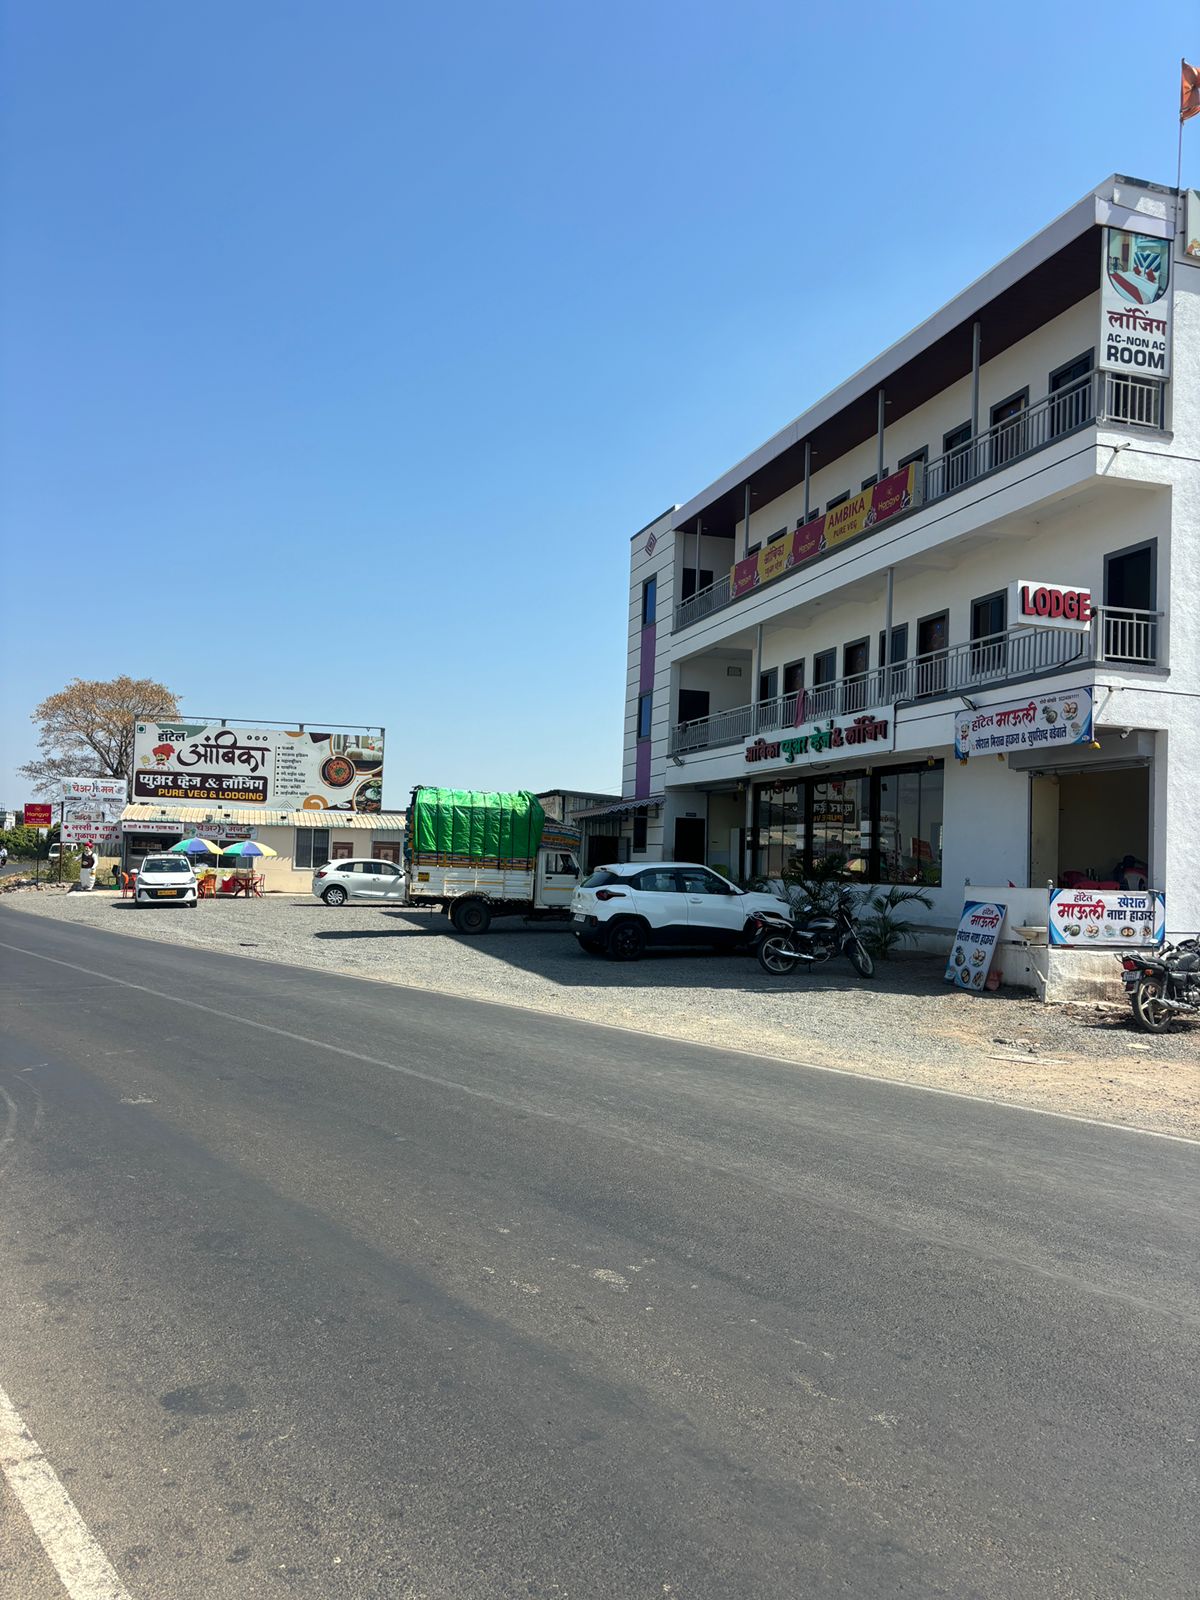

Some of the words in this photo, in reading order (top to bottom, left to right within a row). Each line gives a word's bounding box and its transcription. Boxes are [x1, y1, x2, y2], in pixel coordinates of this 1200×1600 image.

[1106, 307, 1167, 336] लॉजिंग
[1107, 333, 1149, 348] AC-NON
[1152, 341, 1165, 351] AC
[1107, 345, 1165, 370] ROOM
[828, 497, 865, 529] AMBIKA
[833, 525, 846, 538] PURE
[847, 520, 857, 530] VEG
[1021, 586, 1091, 621] LODGE
[971, 715, 994, 732] हॉटेल
[995, 701, 1038, 728] माऊली
[158, 730, 187, 742] हॉटेल
[832, 727, 844, 748] &
[844, 715, 888, 745] लॉजिंग
[1021, 732, 1027, 743] &
[176, 730, 271, 773] आंबिका
[139, 774, 174, 789] प्युअर
[177, 774, 202, 788] व्हेज
[205, 777, 219, 788] &
[222, 776, 264, 790] लॉजिंग
[158, 788, 185, 797] PURE
[187, 789, 208, 798] VEG
[209, 790, 217, 798] &
[219, 791, 263, 800] LODGING
[1074, 892, 1093, 902] हॉटेल
[1117, 895, 1147, 909] स्पेशल
[982, 907, 994, 916] हॉटेल
[1057, 899, 1106, 922] माऊली
[970, 914, 999, 930] माऊली
